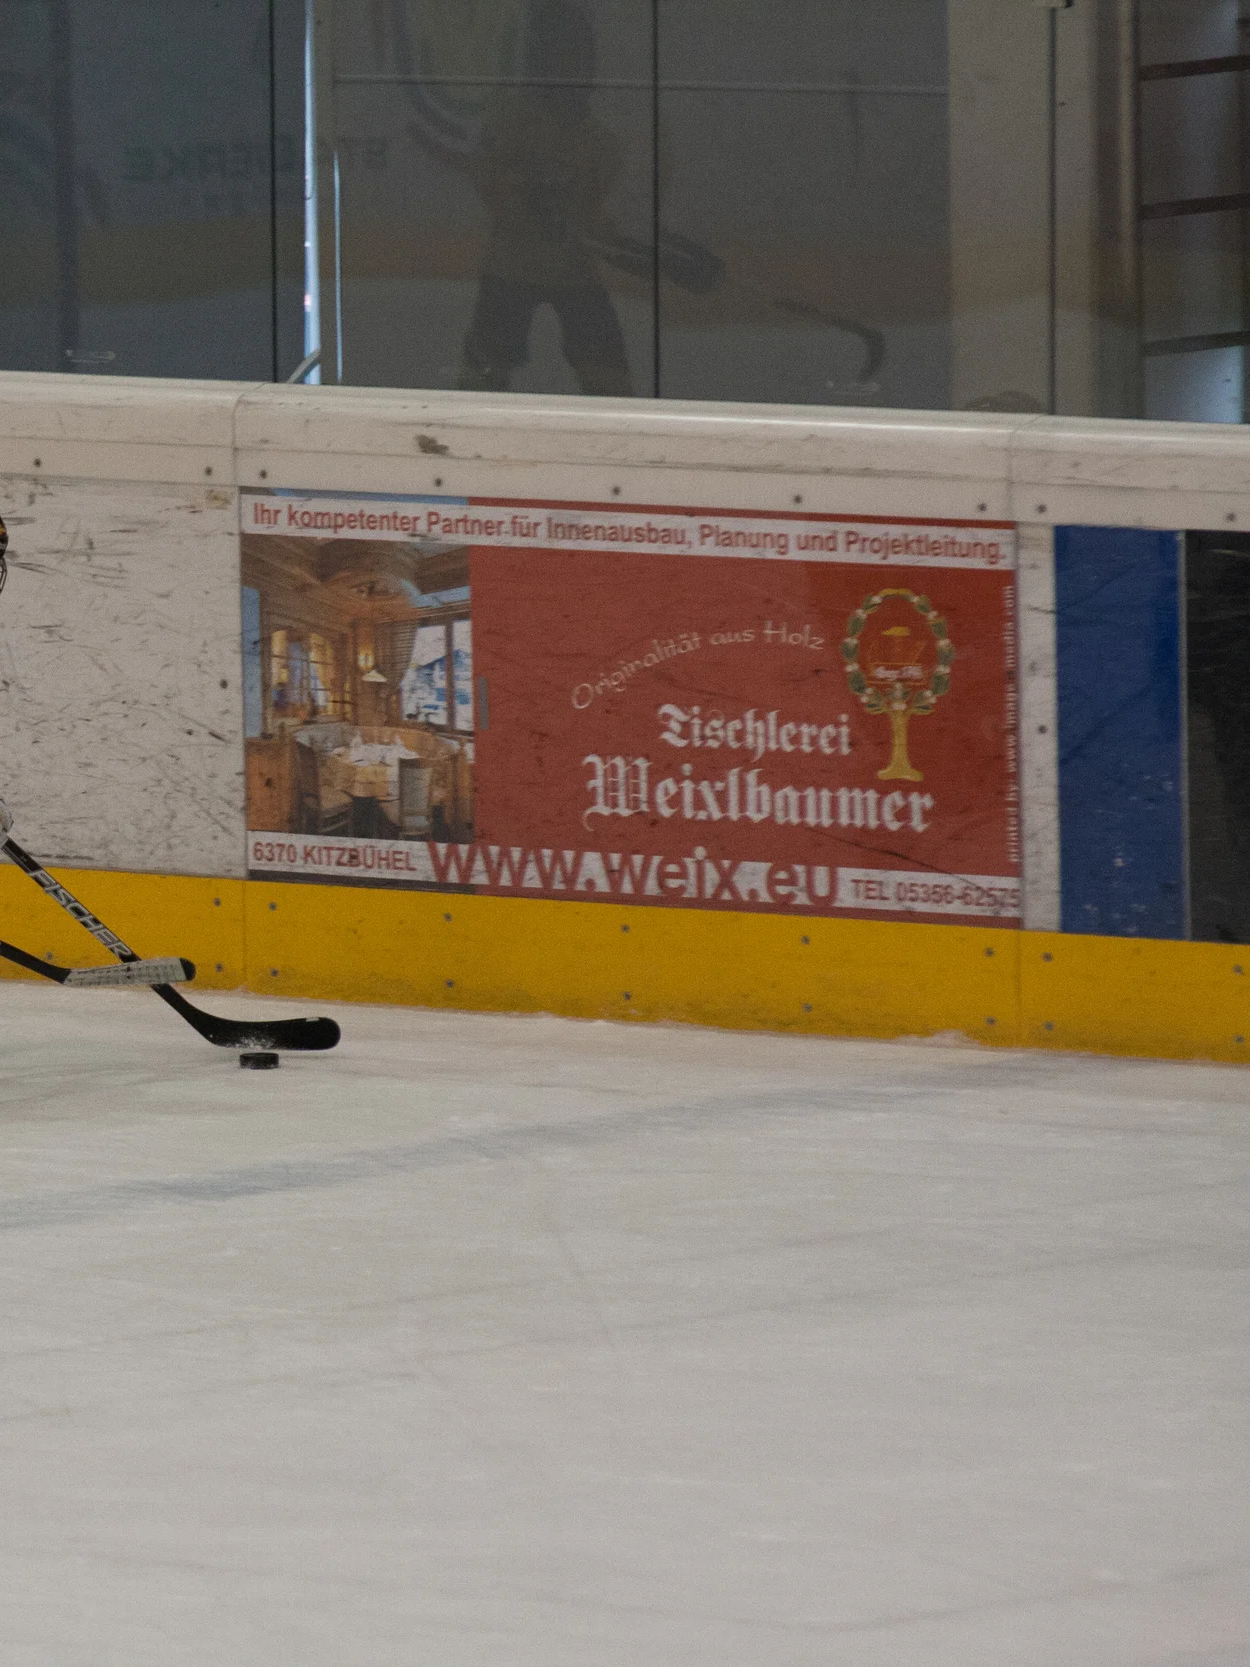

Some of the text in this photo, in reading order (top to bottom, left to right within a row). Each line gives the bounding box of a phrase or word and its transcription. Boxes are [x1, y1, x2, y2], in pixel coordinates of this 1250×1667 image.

[253, 502, 1006, 564] Ihr kompetenter Partner für Innenausbau, Planung und Projektleitung.
[571, 620, 824, 709] Originalität aus Holz
[658, 703, 852, 762] Tischlerei
[582, 753, 934, 833] Weixlbaumer
[253, 842, 297, 863] 6370
[303, 845, 416, 871] KITZBÜHEL
[852, 879, 889, 900] TEL
[29, 868, 134, 957] FISCHER
